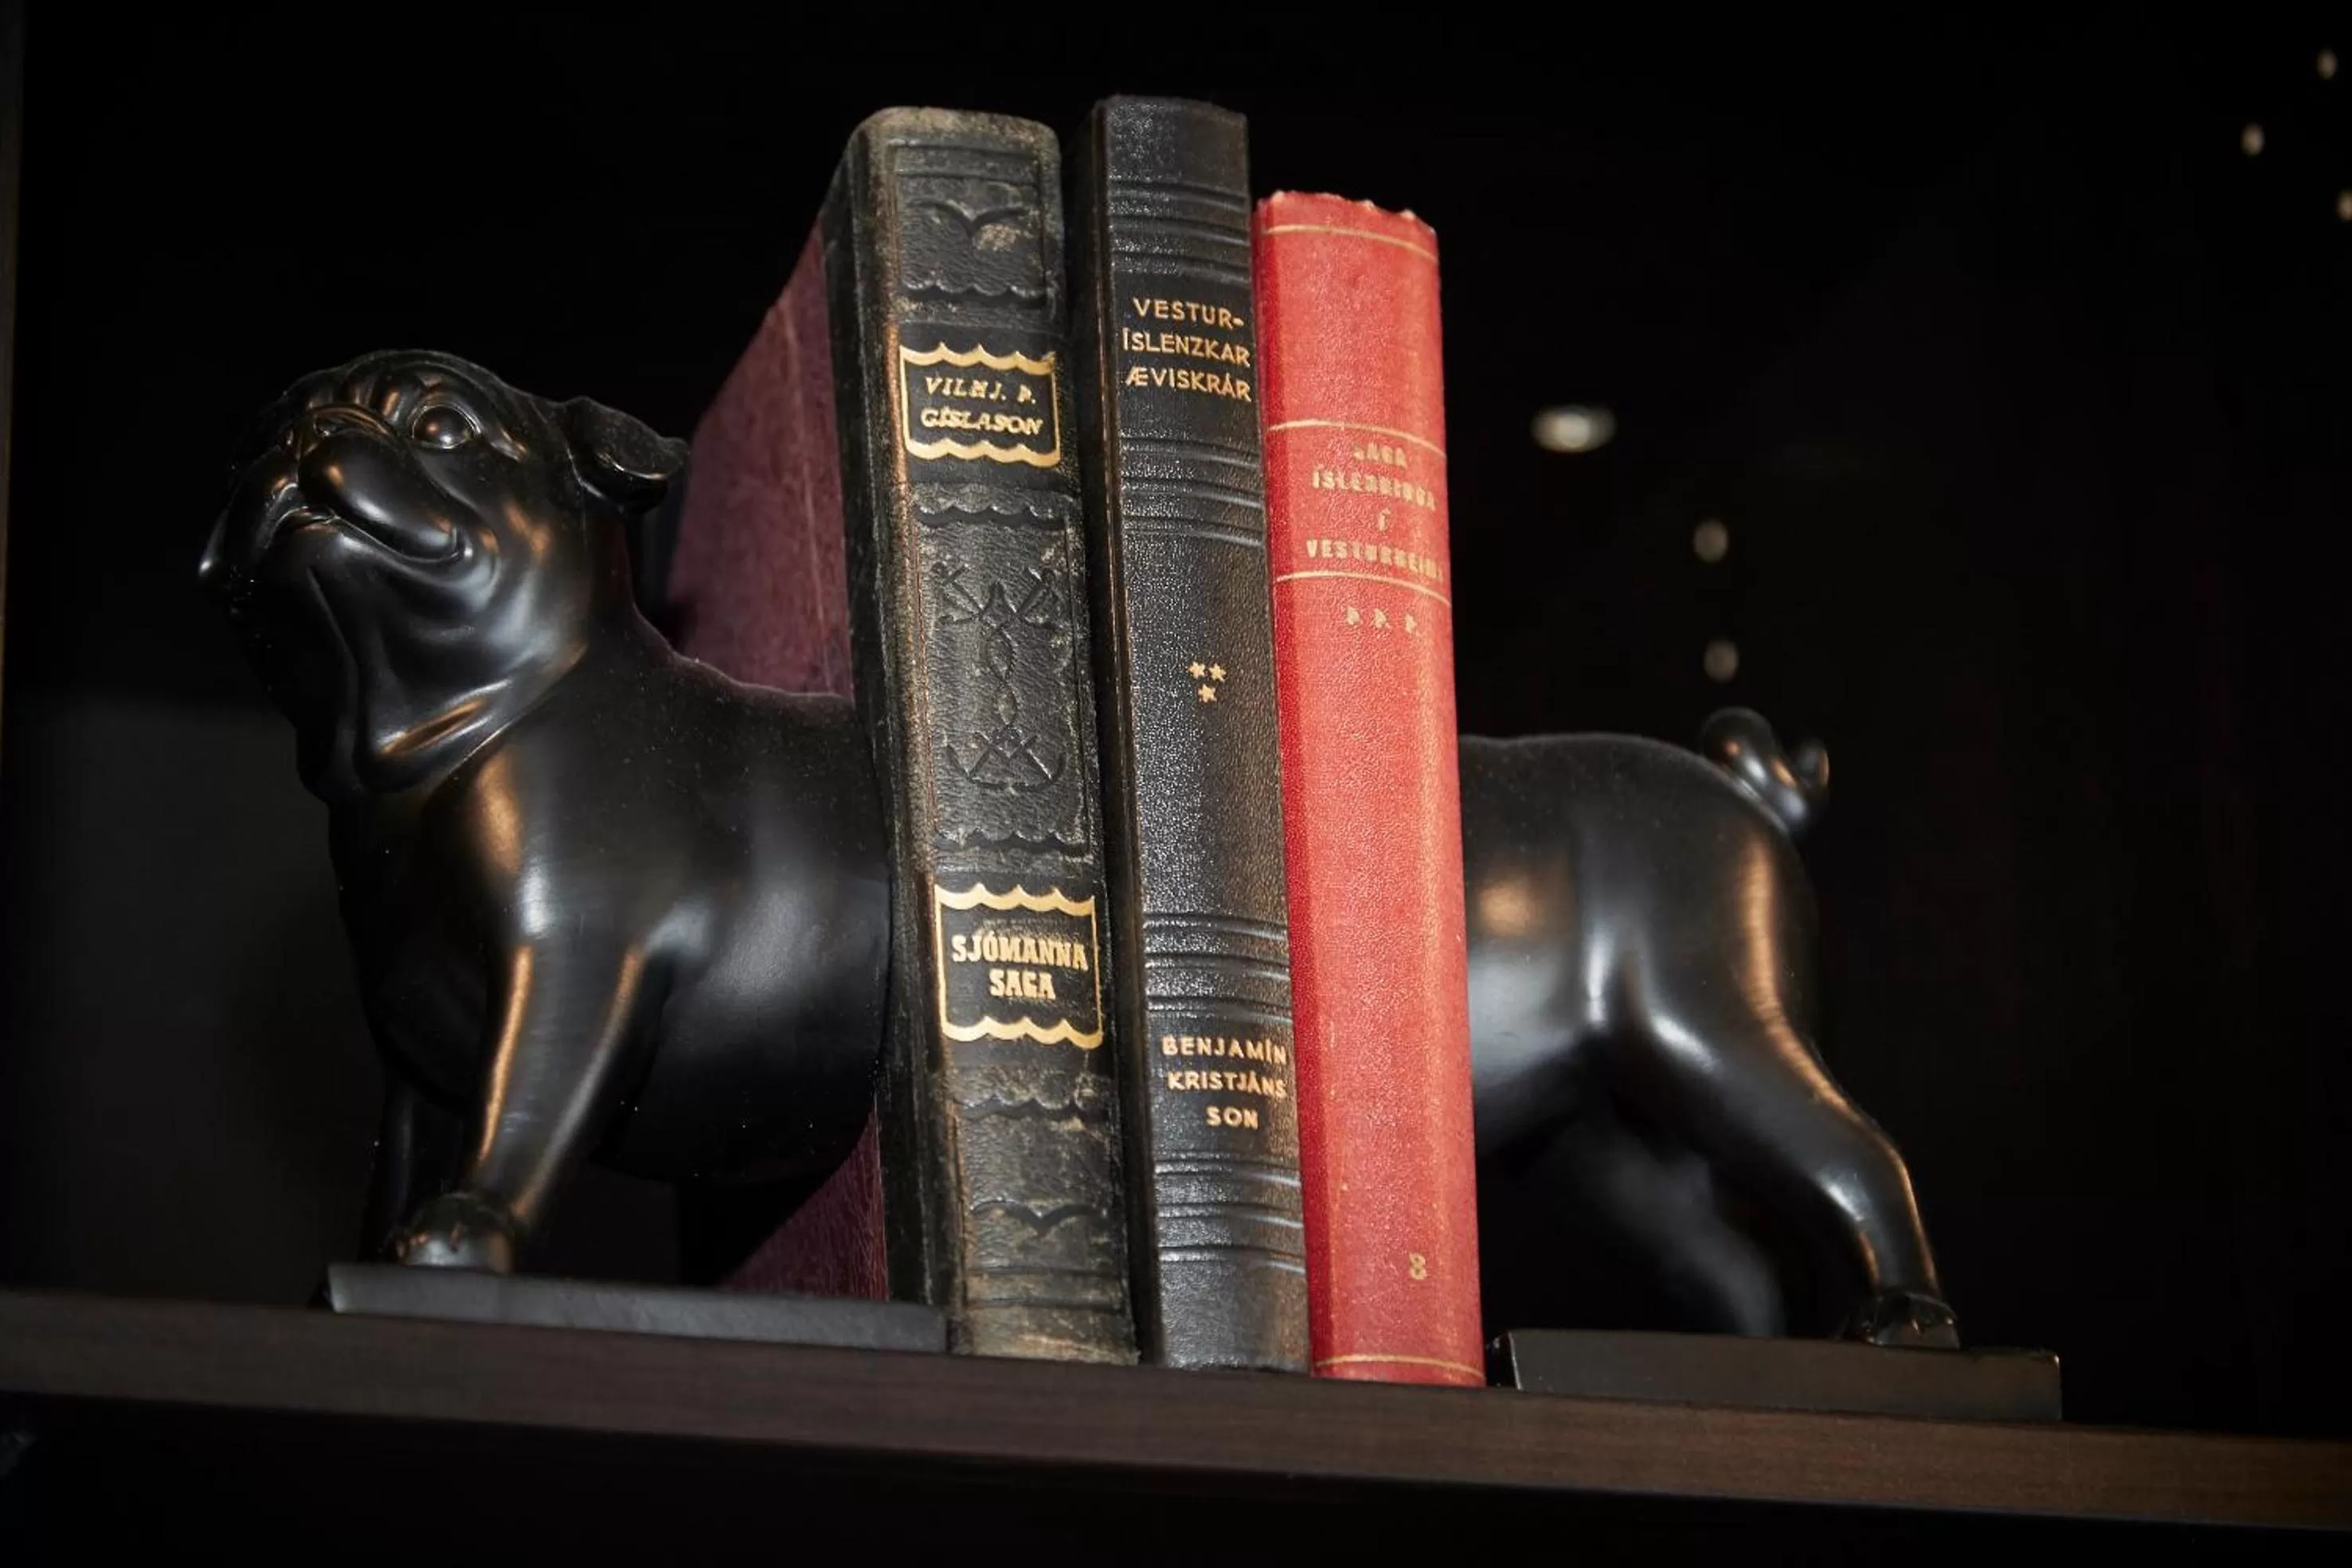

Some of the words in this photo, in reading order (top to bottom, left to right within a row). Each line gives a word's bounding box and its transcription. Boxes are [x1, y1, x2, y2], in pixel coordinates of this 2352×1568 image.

[1133, 296, 1244, 330] VESTUR-
[1125, 366, 1252, 402] ÆVISKRÁR
[951, 930, 1089, 972] SJÓMANNA
[989, 968, 1056, 1000] SAGA
[1161, 1035, 1287, 1066] BENJAMÍN
[1206, 1105, 1259, 1130] SON
